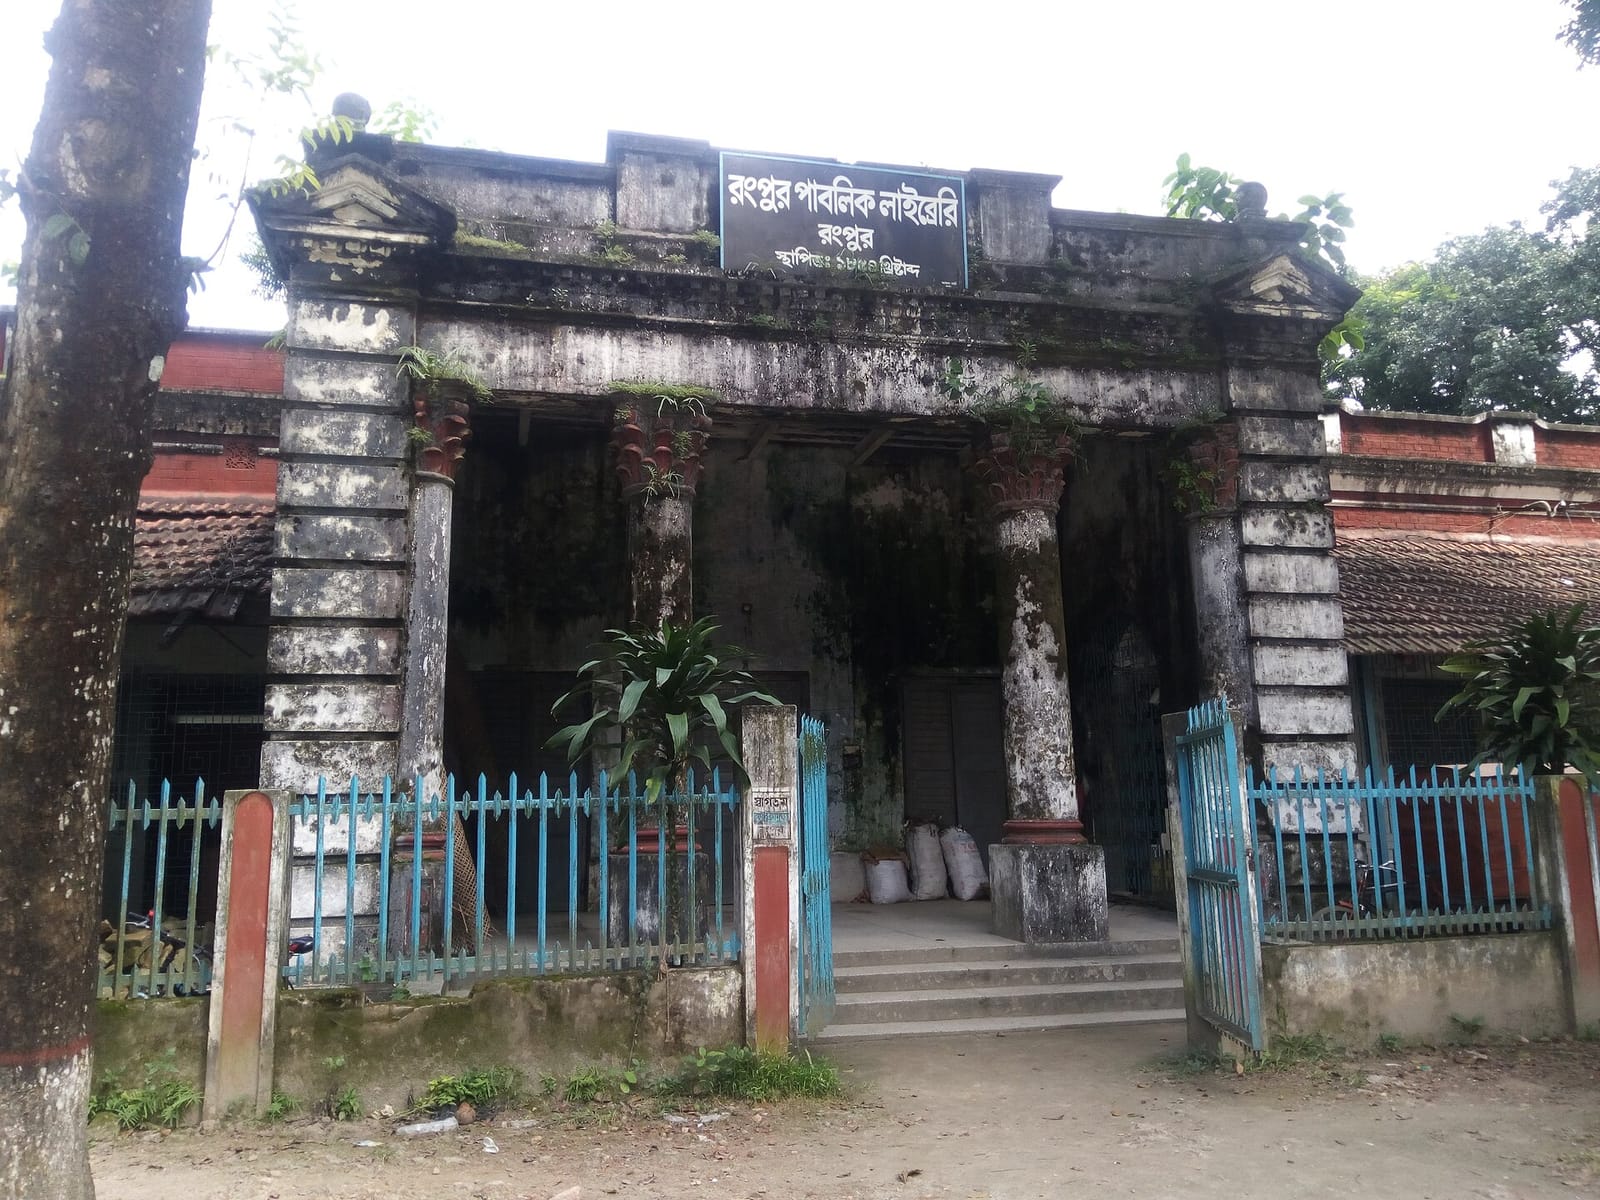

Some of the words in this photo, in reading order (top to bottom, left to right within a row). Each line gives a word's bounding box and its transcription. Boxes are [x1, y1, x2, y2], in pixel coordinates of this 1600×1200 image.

[728, 174, 791, 213] রংপুর
[794, 175, 876, 219] পাবলিক
[879, 182, 959, 227] লাইব্রেরি
[817, 223, 874, 252] রংপুর
